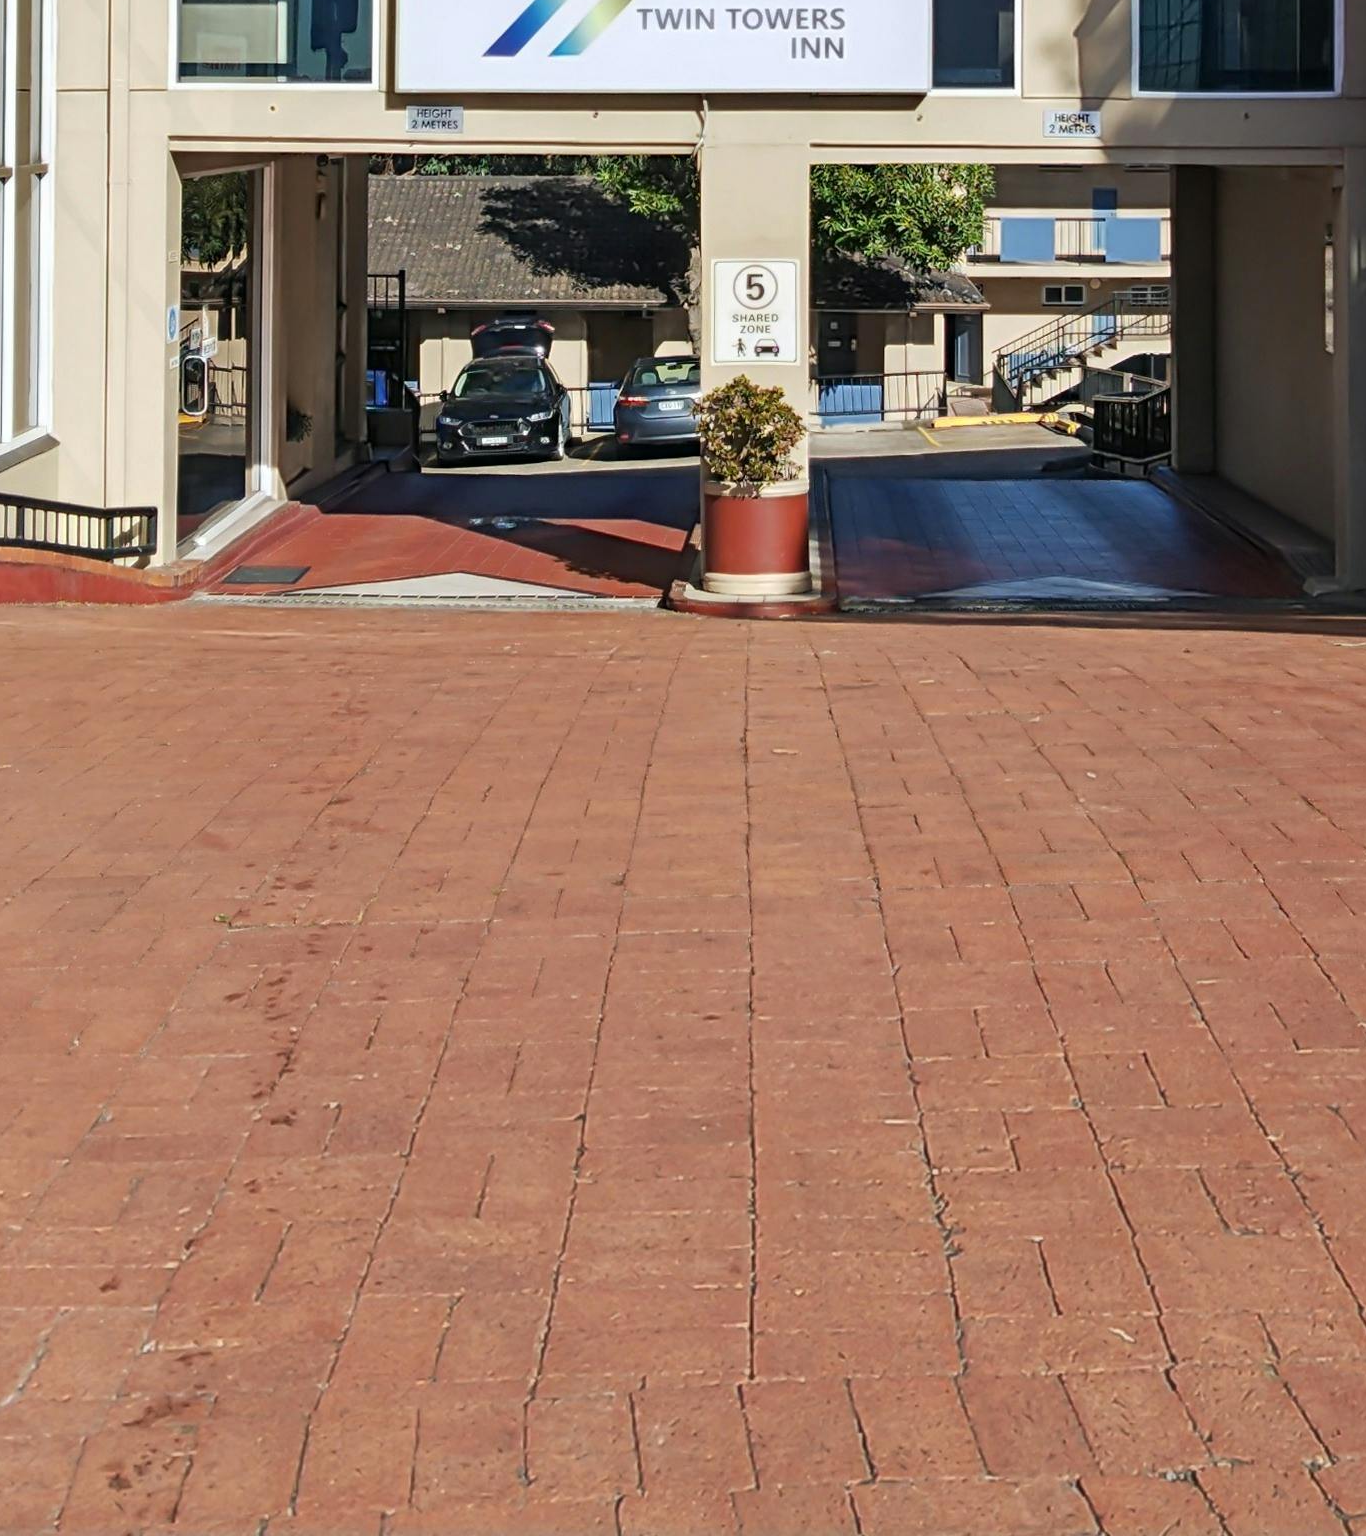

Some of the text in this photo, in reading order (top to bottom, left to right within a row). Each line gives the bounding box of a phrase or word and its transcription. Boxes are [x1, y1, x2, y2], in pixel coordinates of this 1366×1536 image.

[636, 8, 846, 30] TWIN TOWERS
[791, 37, 844, 59] INN
[417, 108, 452, 118] HEIGHT
[1055, 113, 1090, 123] HEIGHT
[411, 120, 458, 130] 2 METRES
[1049, 124, 1095, 134] 2 METRES
[746, 274, 765, 301] 5
[732, 313, 779, 323] SHARED
[740, 325, 771, 334] ZONE
